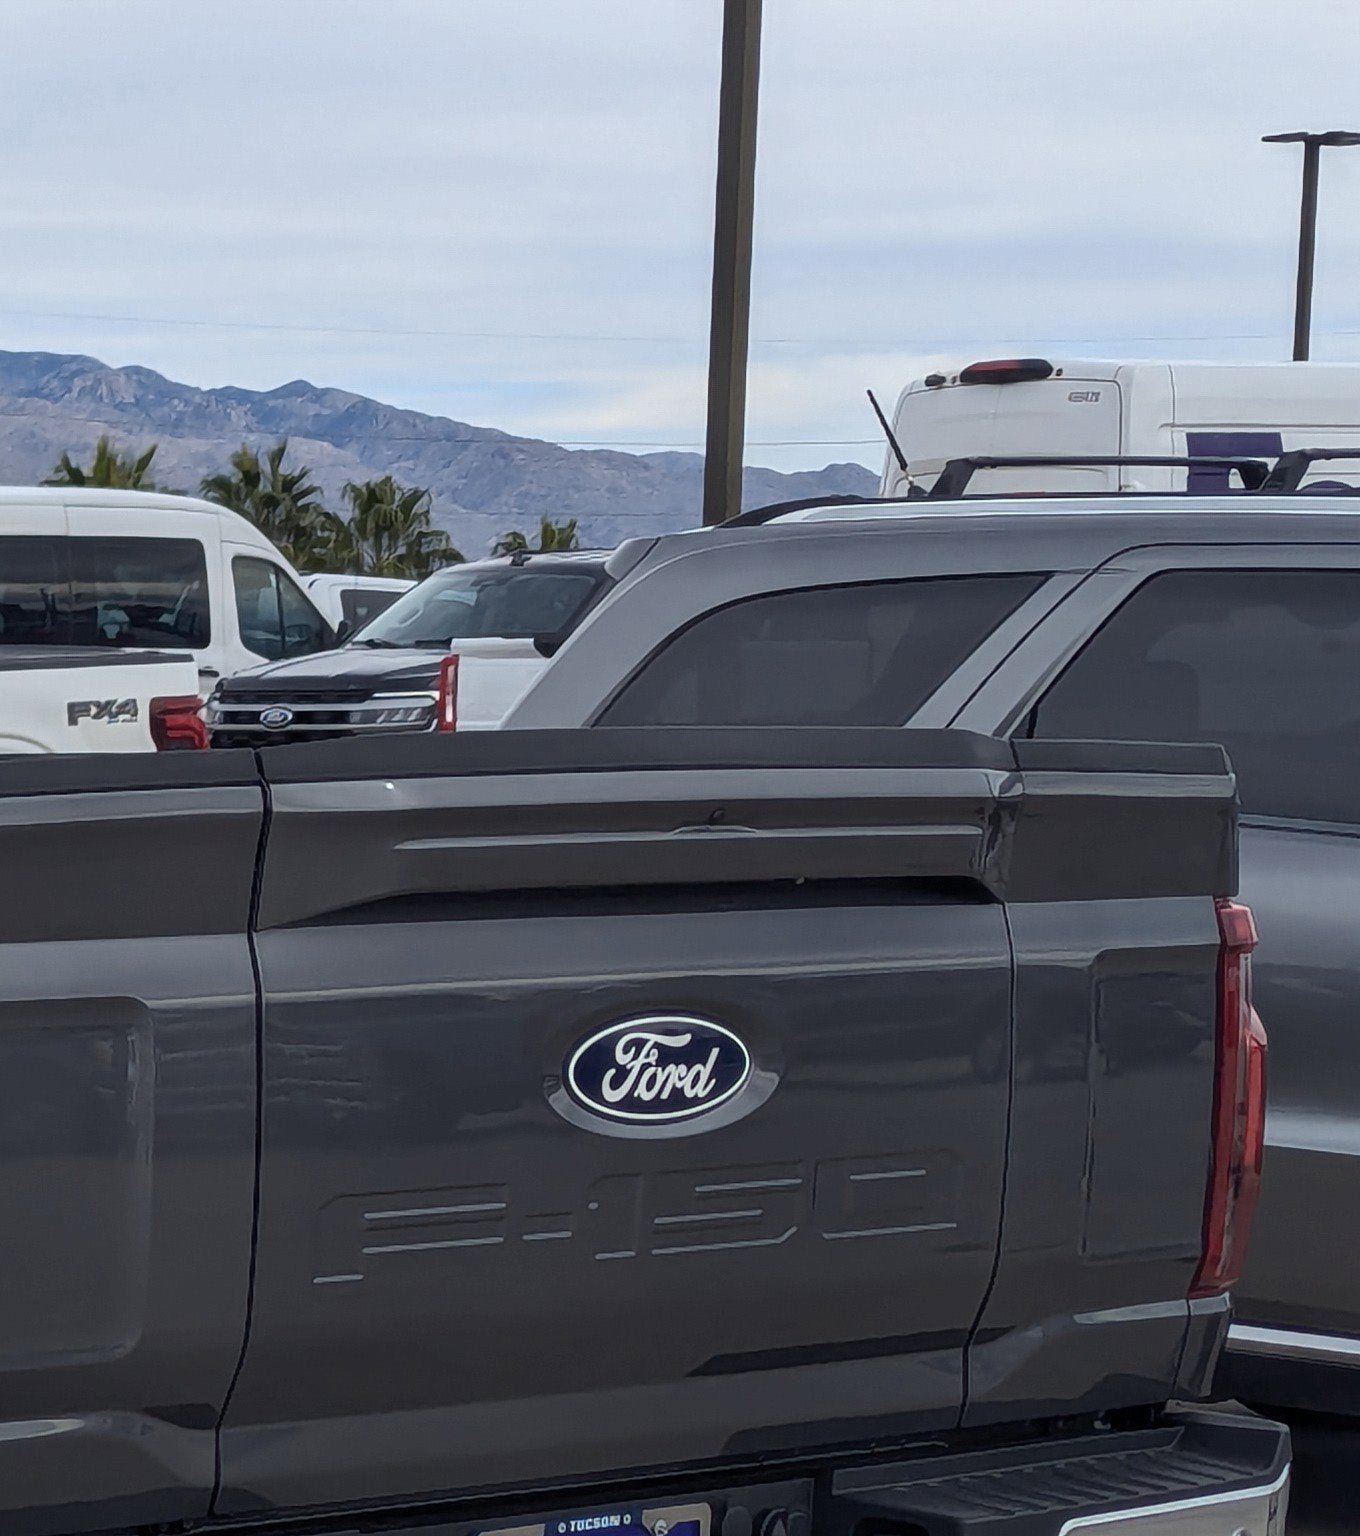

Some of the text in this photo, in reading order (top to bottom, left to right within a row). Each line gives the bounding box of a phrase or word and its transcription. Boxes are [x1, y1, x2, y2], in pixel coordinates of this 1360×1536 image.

[67, 698, 138, 726] FX4
[602, 1031, 718, 1103] Ford
[312, 1148, 963, 1284] F-150
[569, 1514, 621, 1532] TUCSON
